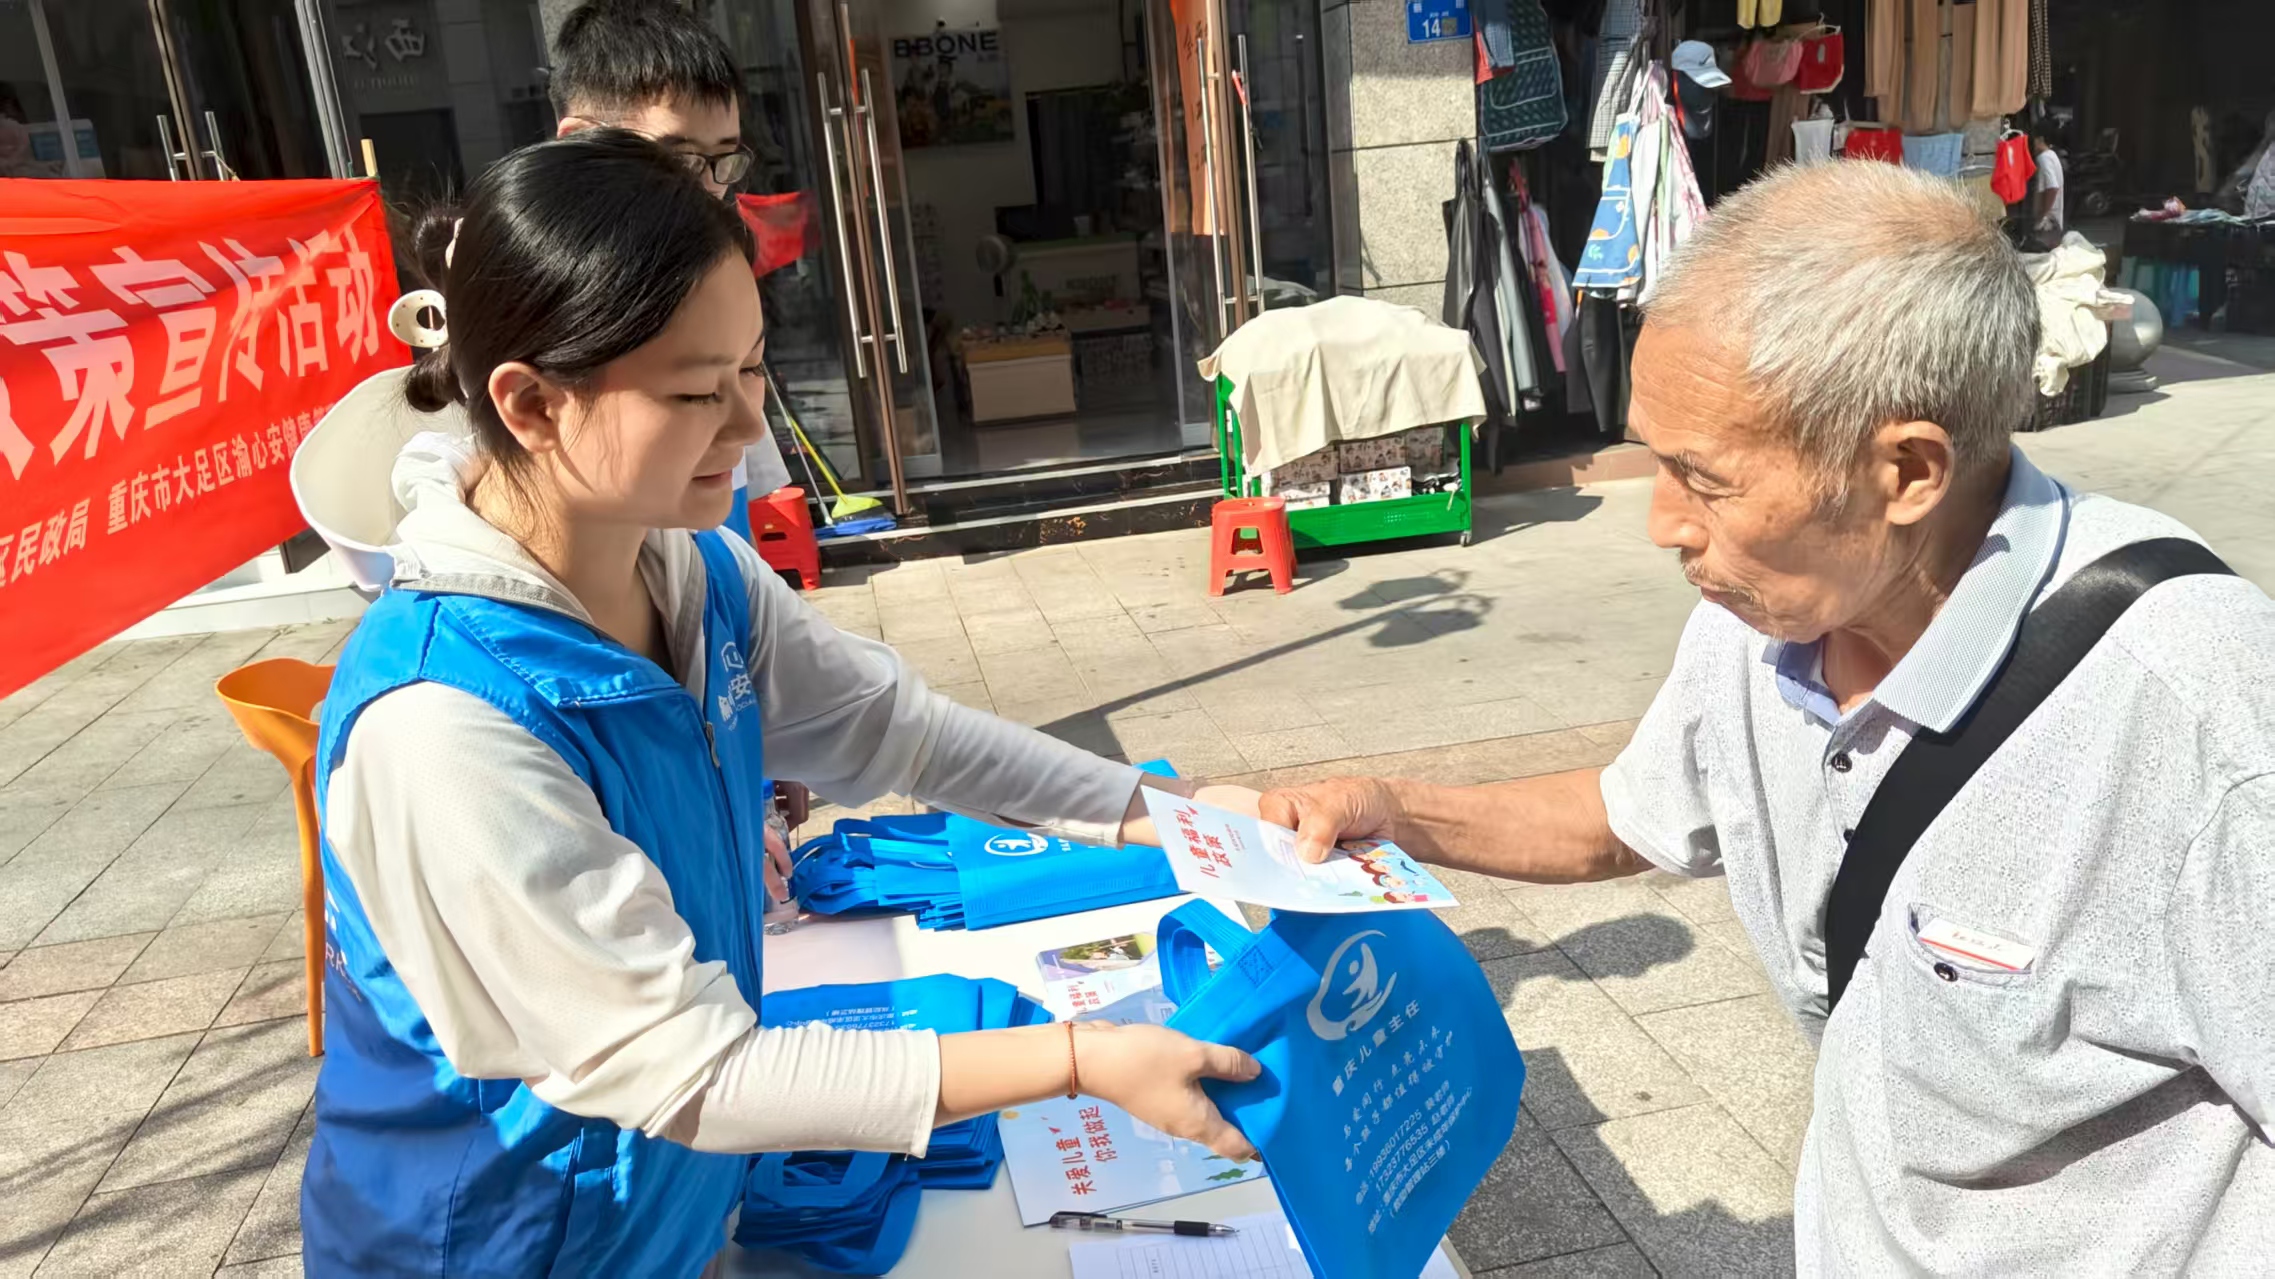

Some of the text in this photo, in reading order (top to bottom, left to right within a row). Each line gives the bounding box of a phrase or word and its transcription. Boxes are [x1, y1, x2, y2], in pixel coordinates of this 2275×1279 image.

[1422, 18, 1441, 38] 14
[0, 222, 380, 480] 策宣传活动
[1173, 809, 1220, 878] 儿童福利
[1202, 833, 1233, 868] 政策
[1332, 1000, 1420, 1097] 重庆儿童主任
[1078, 1105, 1118, 1162] 你我做起
[1375, 1123, 1429, 1191] 17323776535
[1055, 1136, 1097, 1195] 关爱儿童
